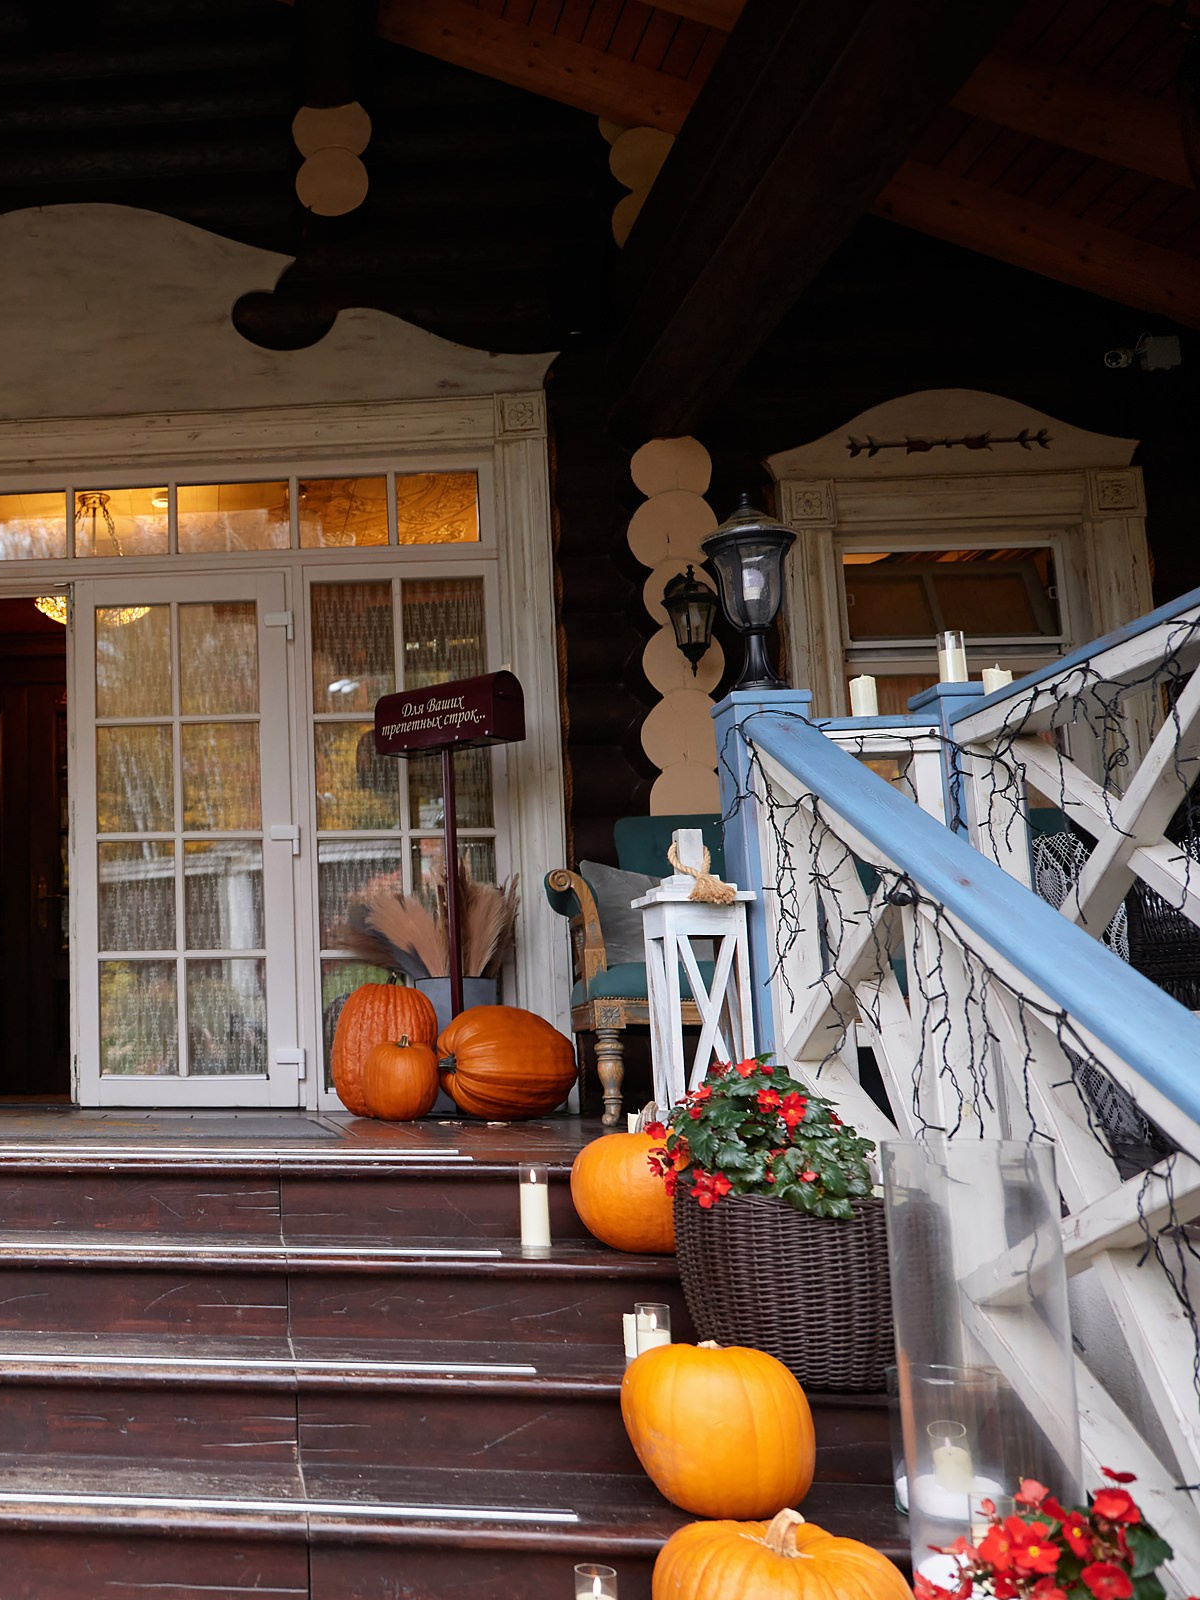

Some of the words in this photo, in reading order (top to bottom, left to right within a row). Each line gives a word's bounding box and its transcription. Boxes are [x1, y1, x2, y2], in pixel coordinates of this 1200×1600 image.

[401, 702, 424, 718] Для
[426, 695, 465, 713] Ваших
[381, 714, 443, 740] трепетных
[443, 708, 486, 728] строк...
